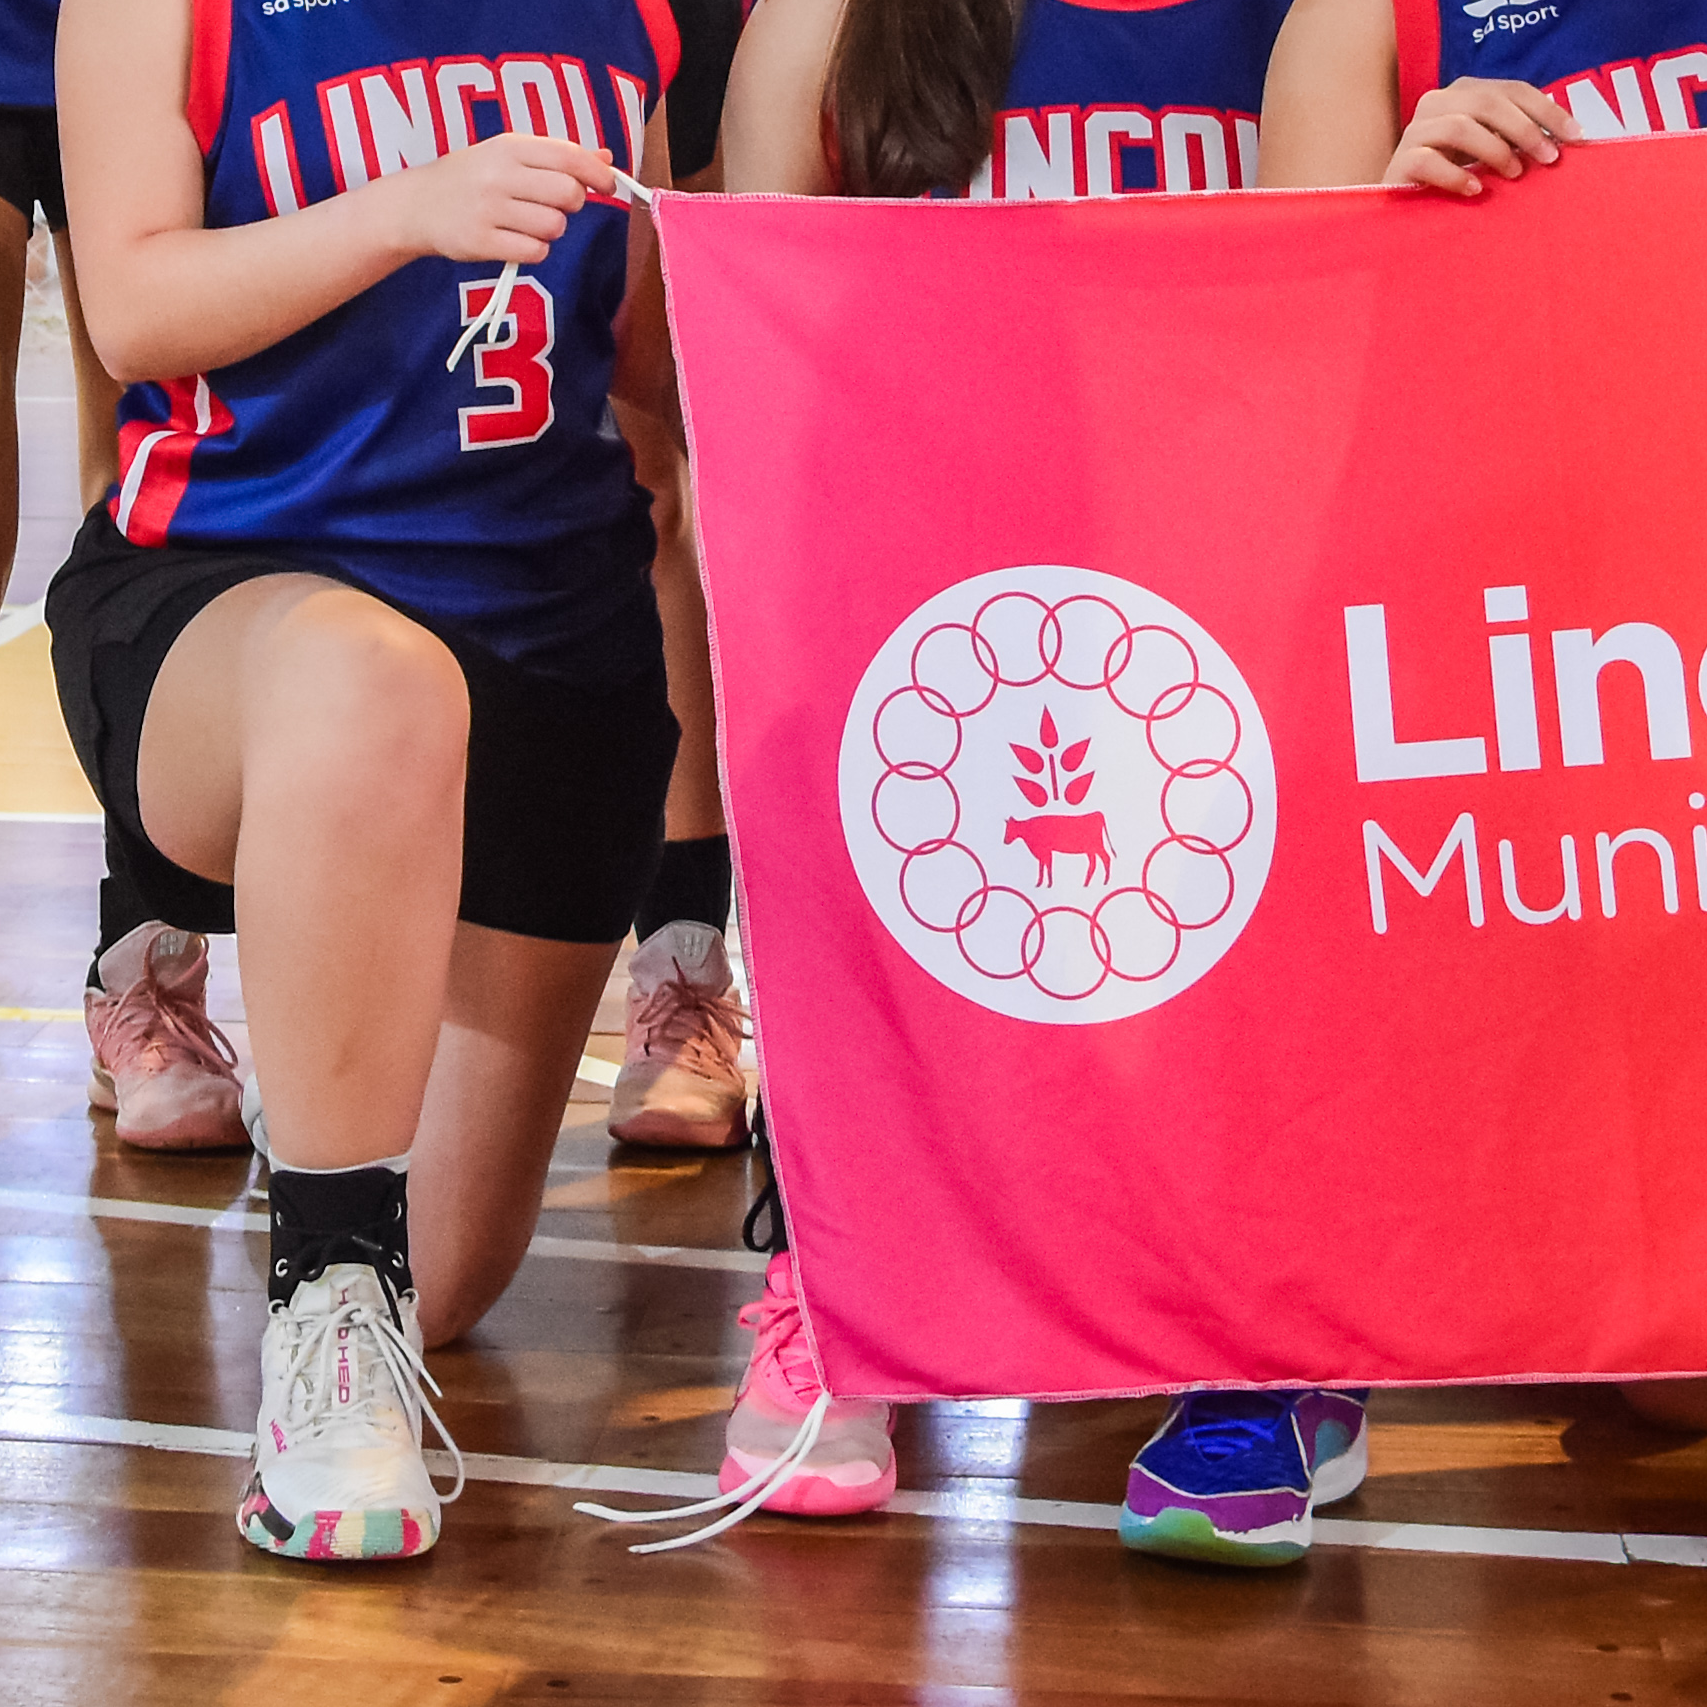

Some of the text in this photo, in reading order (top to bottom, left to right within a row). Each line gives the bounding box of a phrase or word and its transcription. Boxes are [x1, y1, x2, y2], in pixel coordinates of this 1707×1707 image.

[1472, 5, 1560, 44] sd sport
[457, 275, 556, 452] 3
